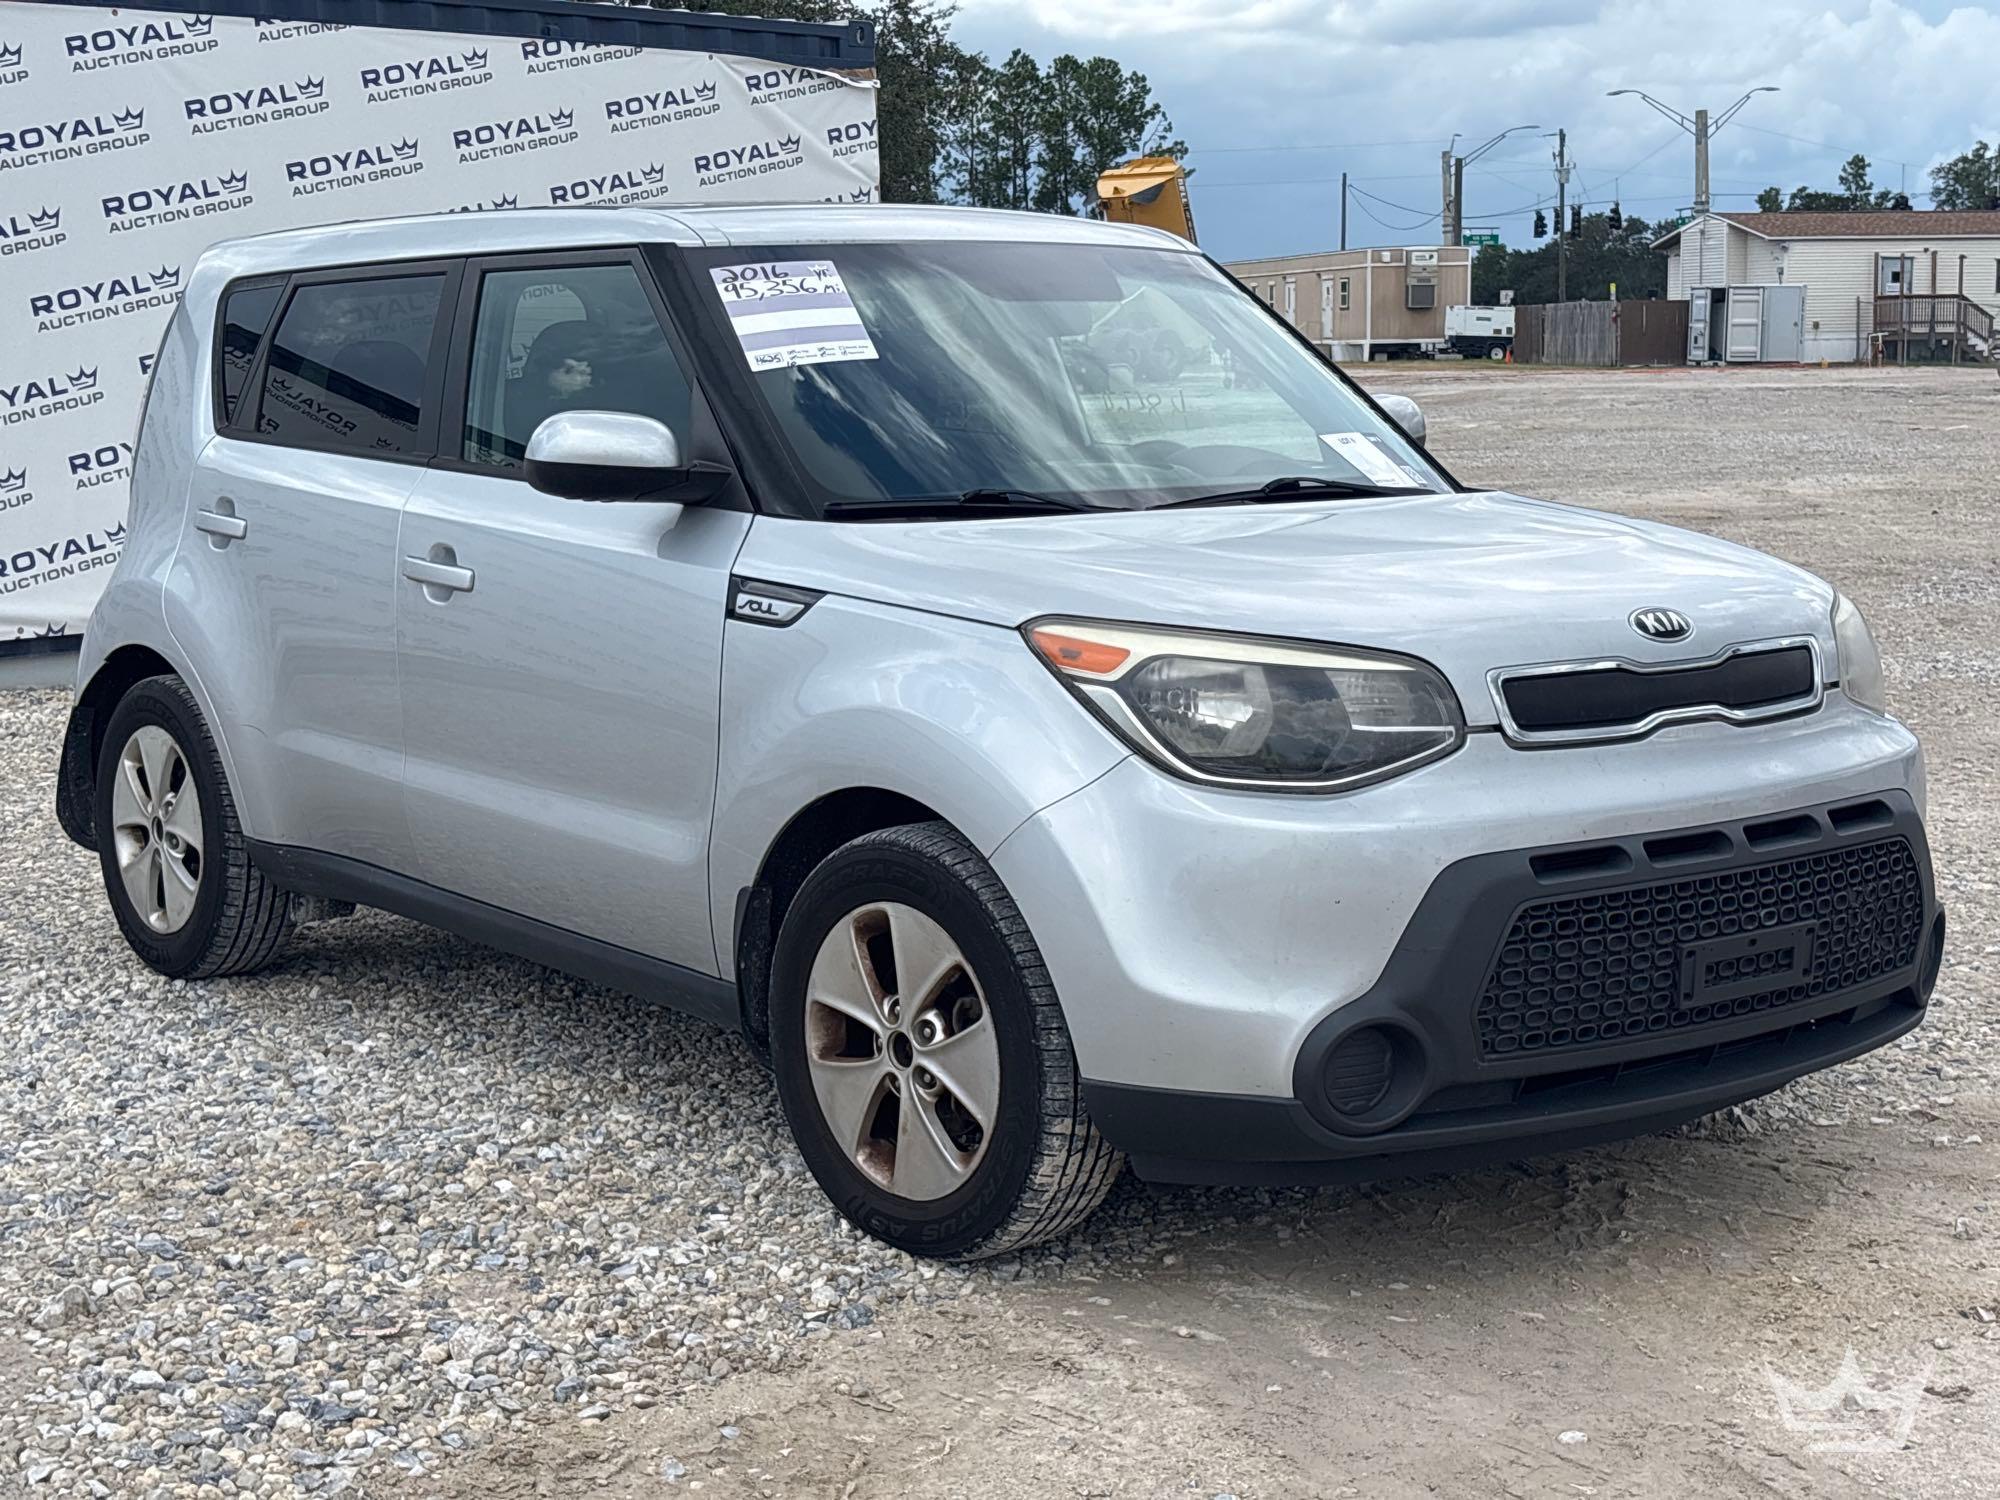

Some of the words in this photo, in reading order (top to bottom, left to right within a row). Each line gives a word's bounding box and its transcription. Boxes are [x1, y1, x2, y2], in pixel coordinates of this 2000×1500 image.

[65, 21, 185, 56] ROYAL
[258, 23, 333, 43] AUCTION
[72, 50, 154, 73] AUCTION
[157, 39, 219, 59] GROUP
[361, 56, 464, 88] ROYAL
[527, 56, 591, 75] AUCTION
[594, 46, 643, 64] GROUP
[184, 84, 297, 119] ROYAL
[367, 82, 437, 104] AUCTION
[439, 72, 493, 91] GROUP
[605, 88, 695, 120] ROYAL
[750, 87, 806, 106] AUCTION
[0, 116, 114, 152] ROYAL
[191, 112, 268, 135] AUCTION
[270, 101, 330, 121] GROUP
[453, 116, 551, 149] ROYAL
[610, 113, 672, 133] AUCTION
[674, 103, 721, 121] GROUP
[0, 146, 82, 170] AUCTION
[86, 133, 150, 155] GROUP
[459, 141, 525, 164] AUCTION
[528, 131, 579, 150] GROUP
[694, 142, 779, 173] ROYAL
[285, 146, 394, 182] ROYAL
[292, 173, 365, 197] AUCTION
[368, 162, 423, 182] GROUP
[699, 167, 756, 187] AUCTION
[759, 156, 803, 174] GROUP
[102, 179, 219, 217] ROYAL
[550, 171, 642, 204] ROYAL
[621, 186, 669, 204] GROUP
[109, 207, 190, 233] AUCTION
[193, 195, 253, 216] GROUP
[1, 233, 67, 256] GROUP
[720, 264, 789, 283] 2016
[723, 278, 818, 301] 95,356
[30, 275, 150, 317] ROYAL
[38, 305, 120, 333] AUCTION
[40, 391, 104, 416] GROUP
[0, 564, 74, 595] UCTION
[1638, 611, 1689, 633] KIA
